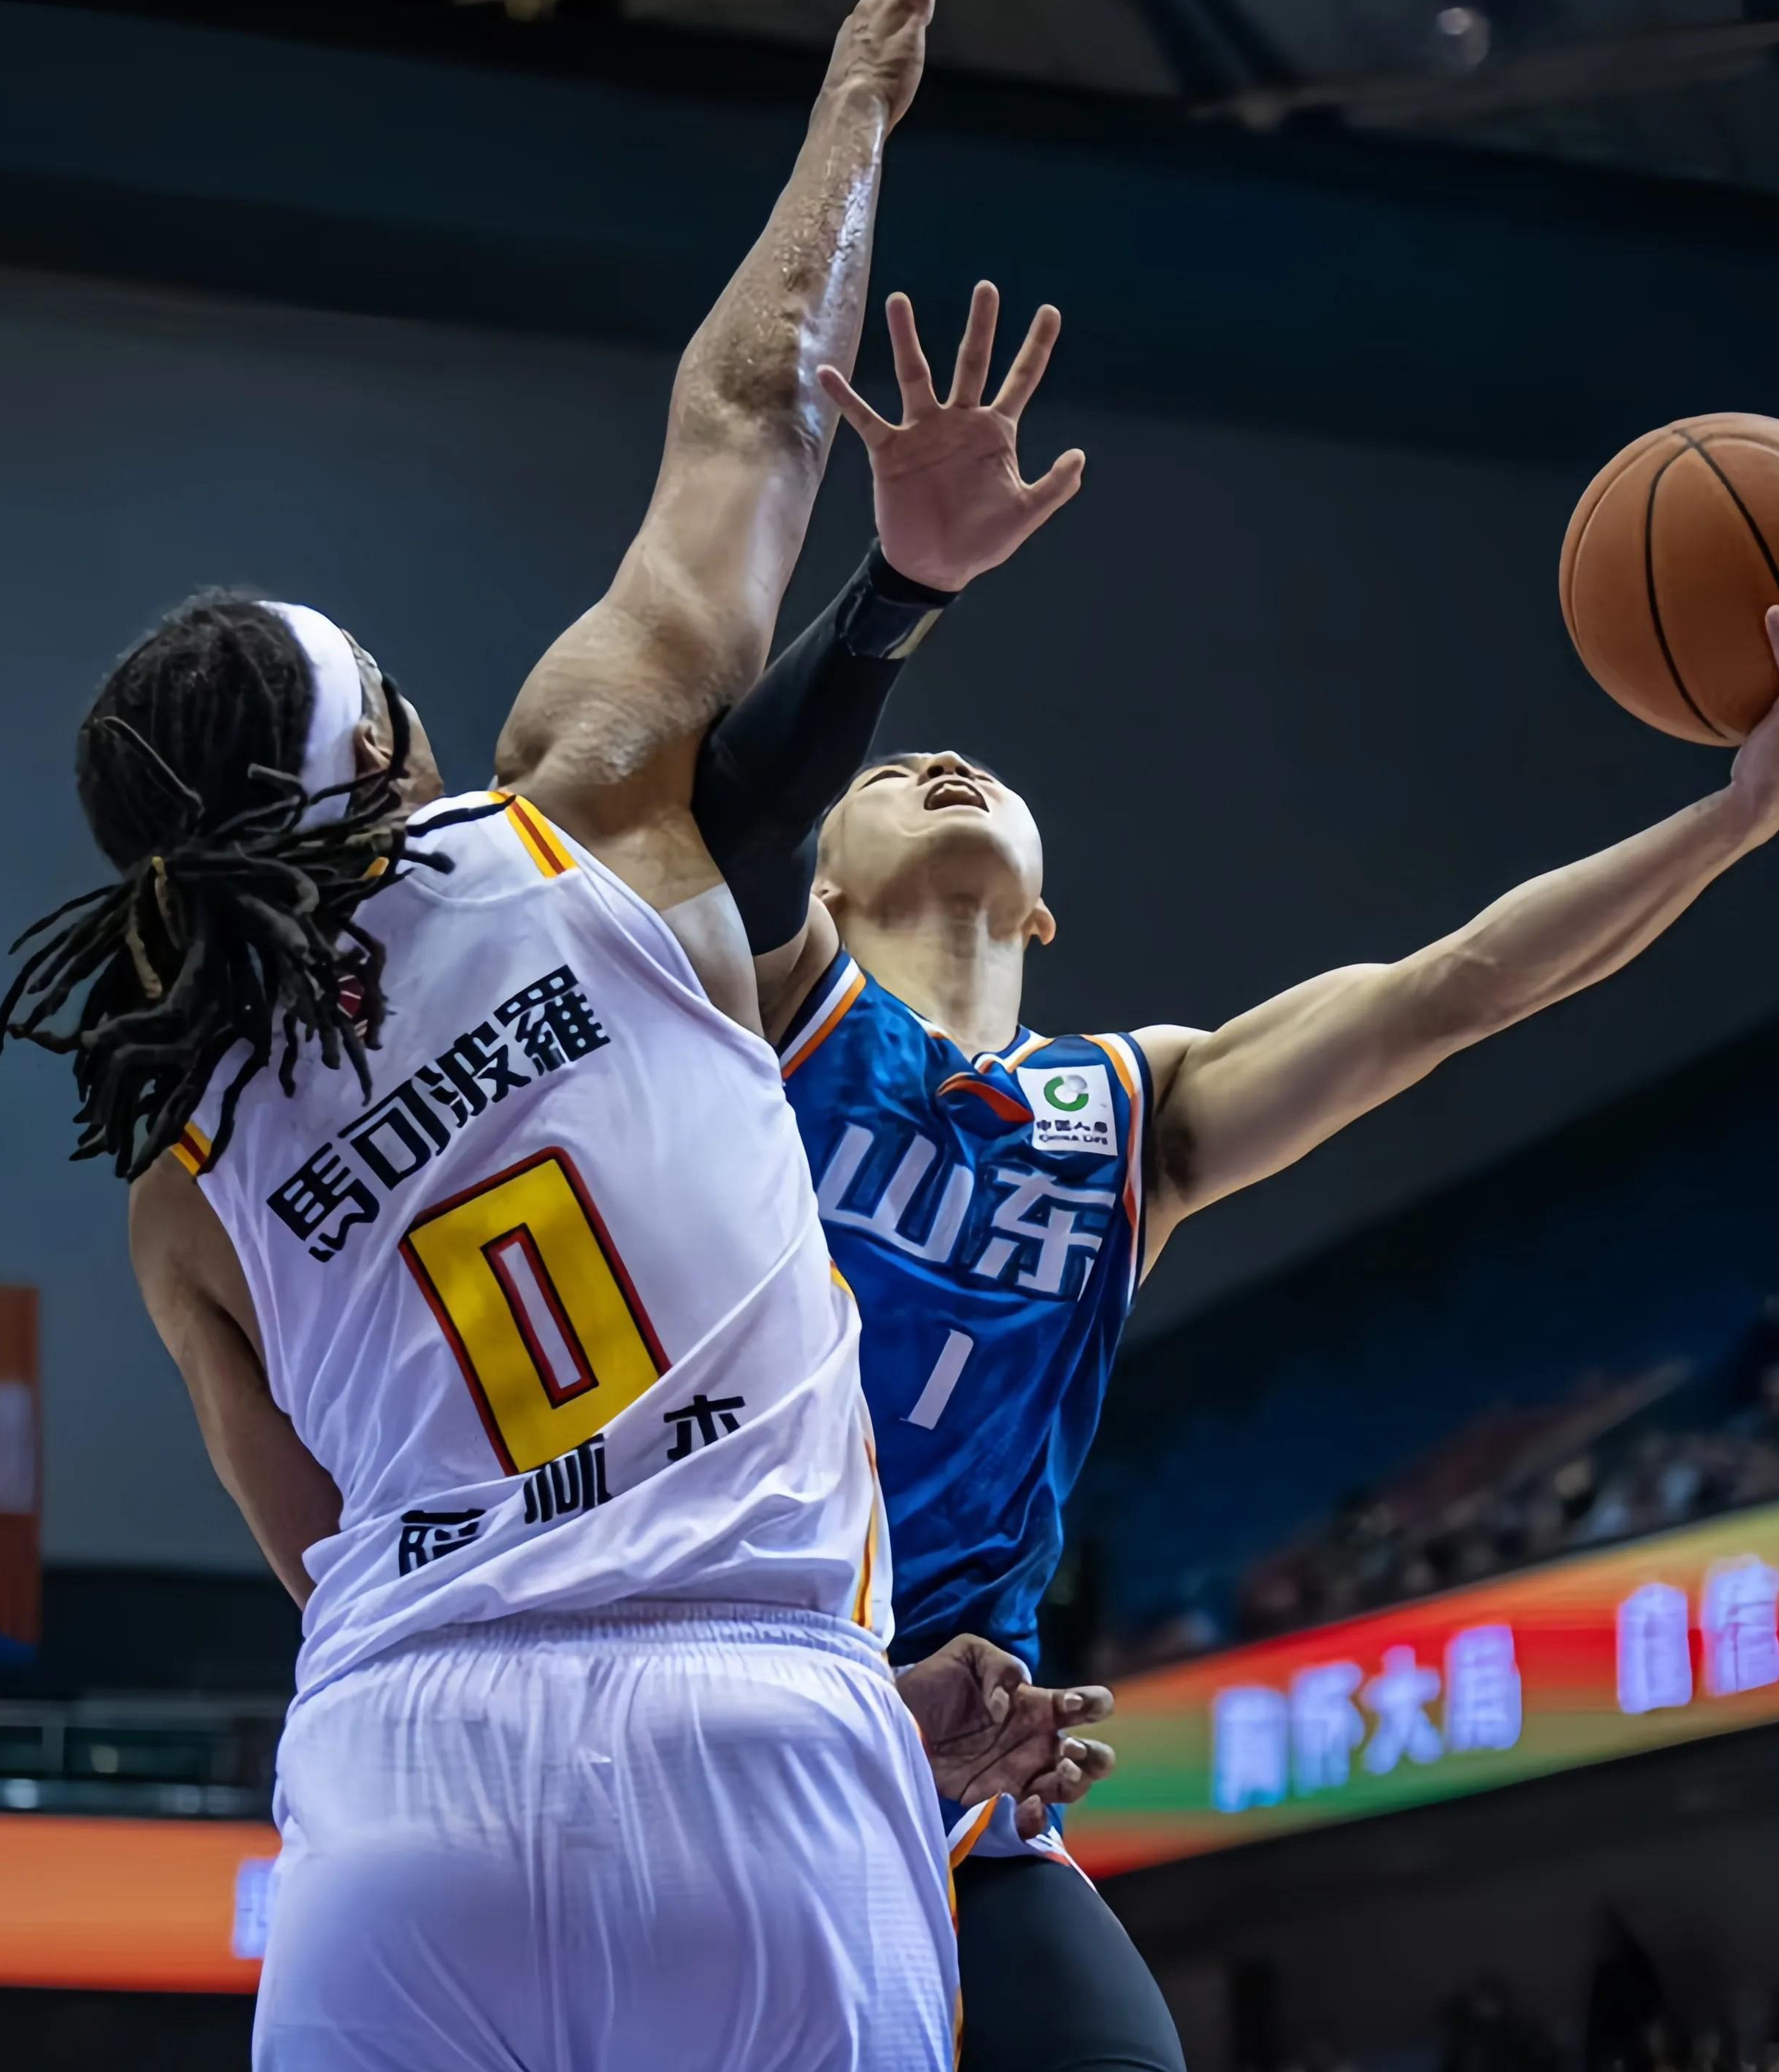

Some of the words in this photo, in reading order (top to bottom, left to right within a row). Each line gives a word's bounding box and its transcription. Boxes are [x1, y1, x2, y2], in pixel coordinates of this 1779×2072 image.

[266, 965, 611, 1263] 馬可波羅
[817, 1121, 1116, 1302] 山东
[398, 1146, 672, 1476] 0
[903, 1328, 974, 1430] 1
